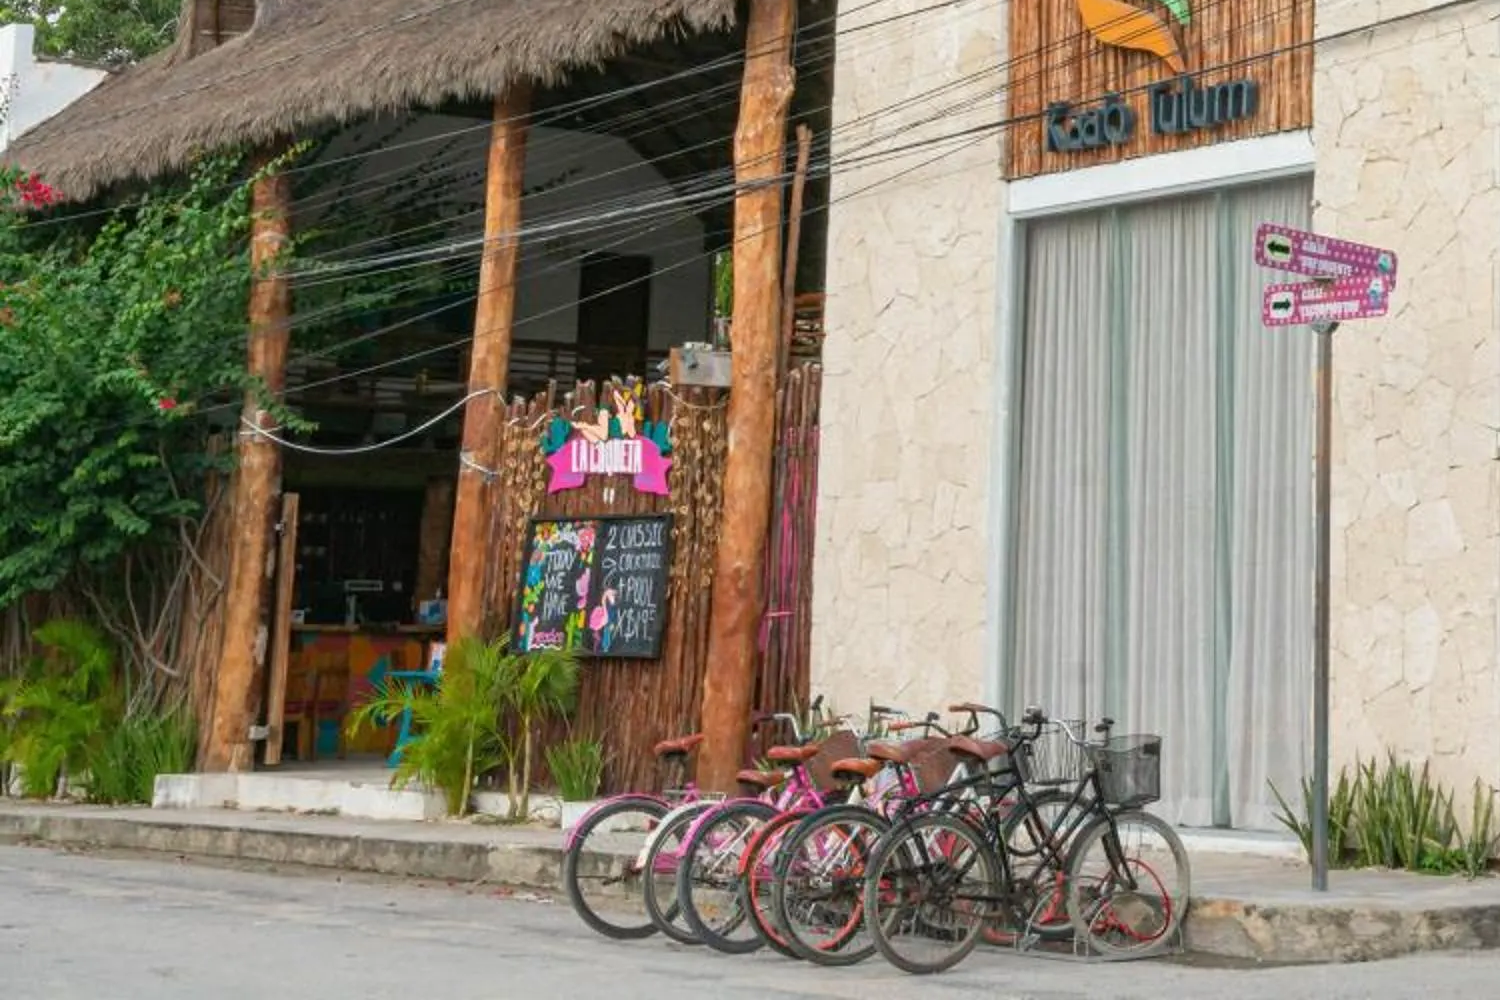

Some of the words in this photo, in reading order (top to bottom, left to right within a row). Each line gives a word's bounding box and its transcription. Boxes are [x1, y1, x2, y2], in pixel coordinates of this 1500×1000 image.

[1149, 75, 1259, 136] Tulum
[571, 439, 588, 473] LA
[605, 525, 617, 550] 2
